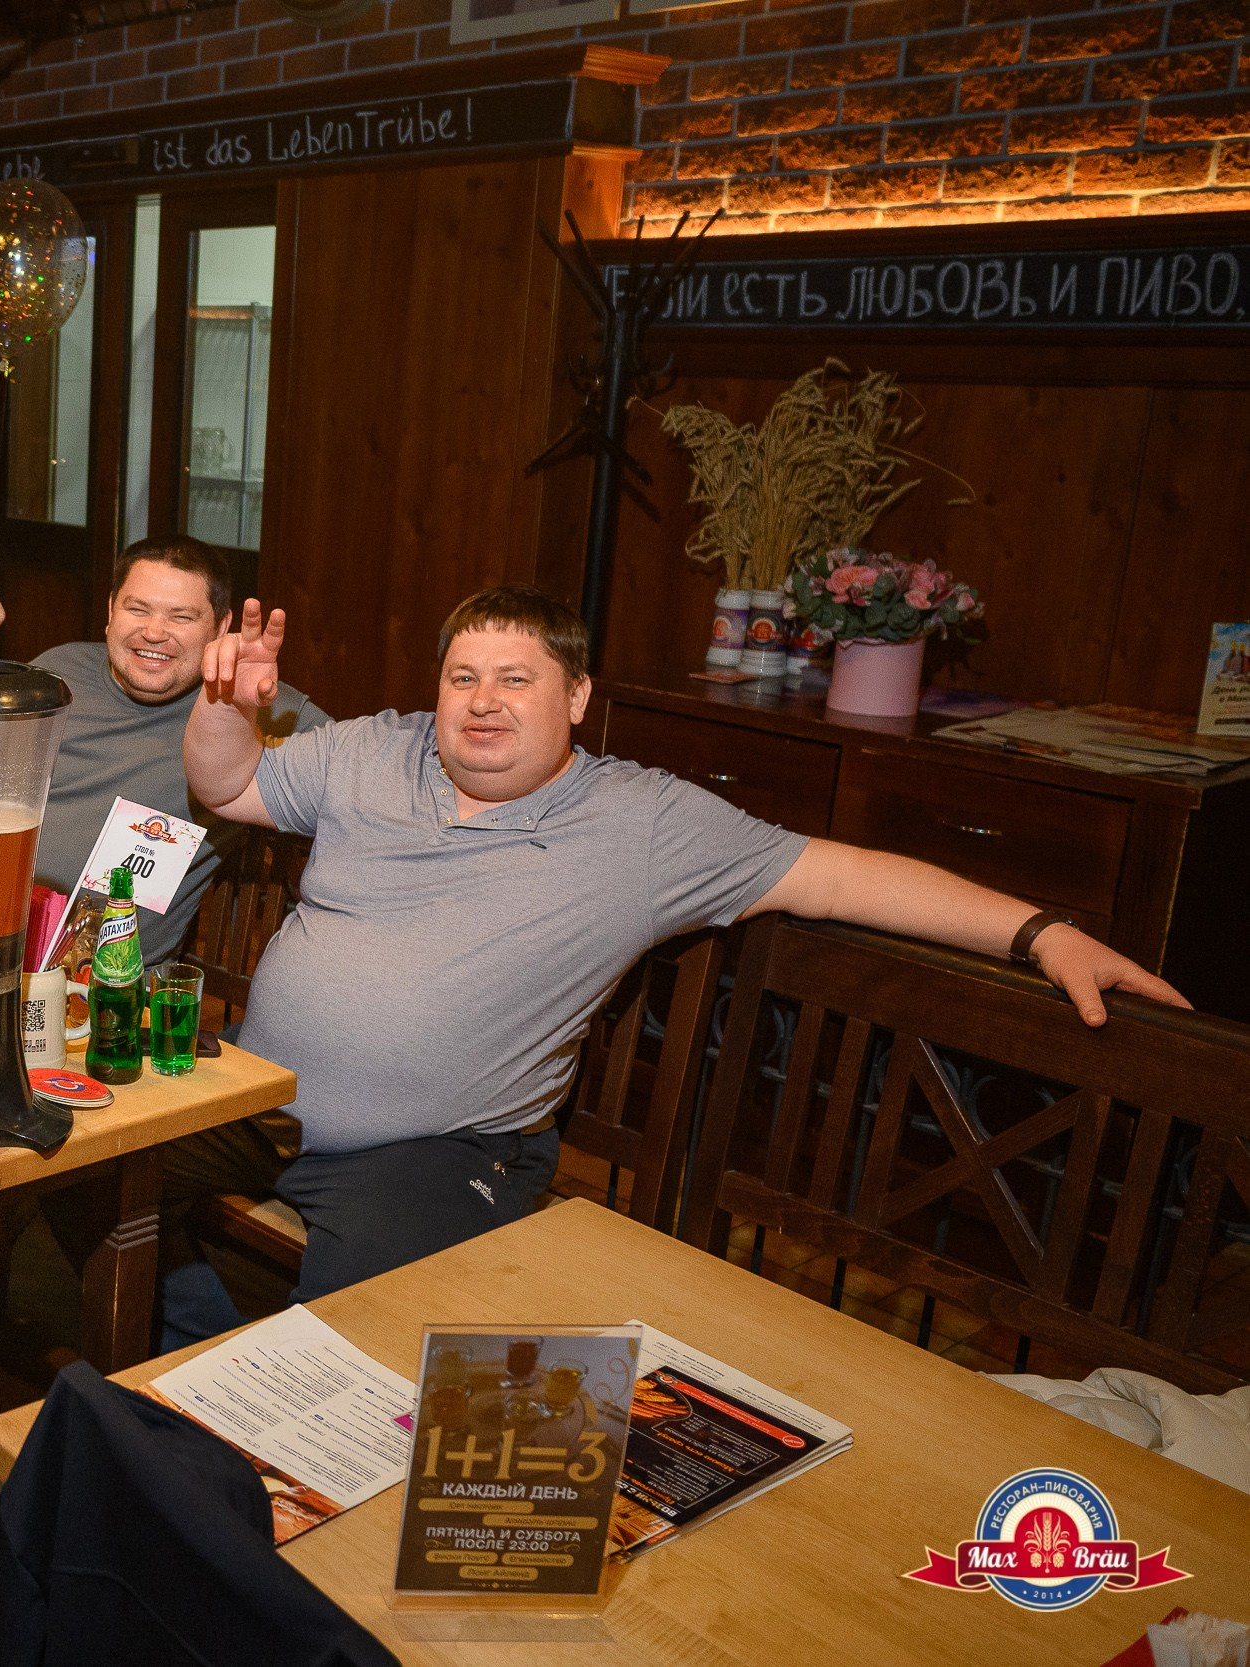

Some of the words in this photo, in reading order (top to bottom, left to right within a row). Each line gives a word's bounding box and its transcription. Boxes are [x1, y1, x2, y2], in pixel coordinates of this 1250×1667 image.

[152, 132, 192, 172] ist
[205, 128, 252, 167] das
[266, 114, 353, 162] Leben
[836, 258, 1038, 320] ЛЮБОВЬ
[1049, 262, 1078, 317] И
[1095, 251, 1246, 321] ПИВО,
[134, 844, 150, 854] СТОЛ
[120, 853, 156, 879] 400
[421, 1425, 608, 1484] 1+1=3
[442, 1482, 526, 1498] КАЖДЫЙ
[529, 1486, 579, 1500] ДЕНЬ
[634, 1491, 678, 1518] ВОЗЬМИ
[425, 1526, 496, 1540] ПЯТНИЦА
[499, 1528, 511, 1540] И
[514, 1529, 581, 1542] СУББОТА
[454, 1538, 505, 1551] ПОСЛЕ
[508, 1539, 549, 1552] 23:00
